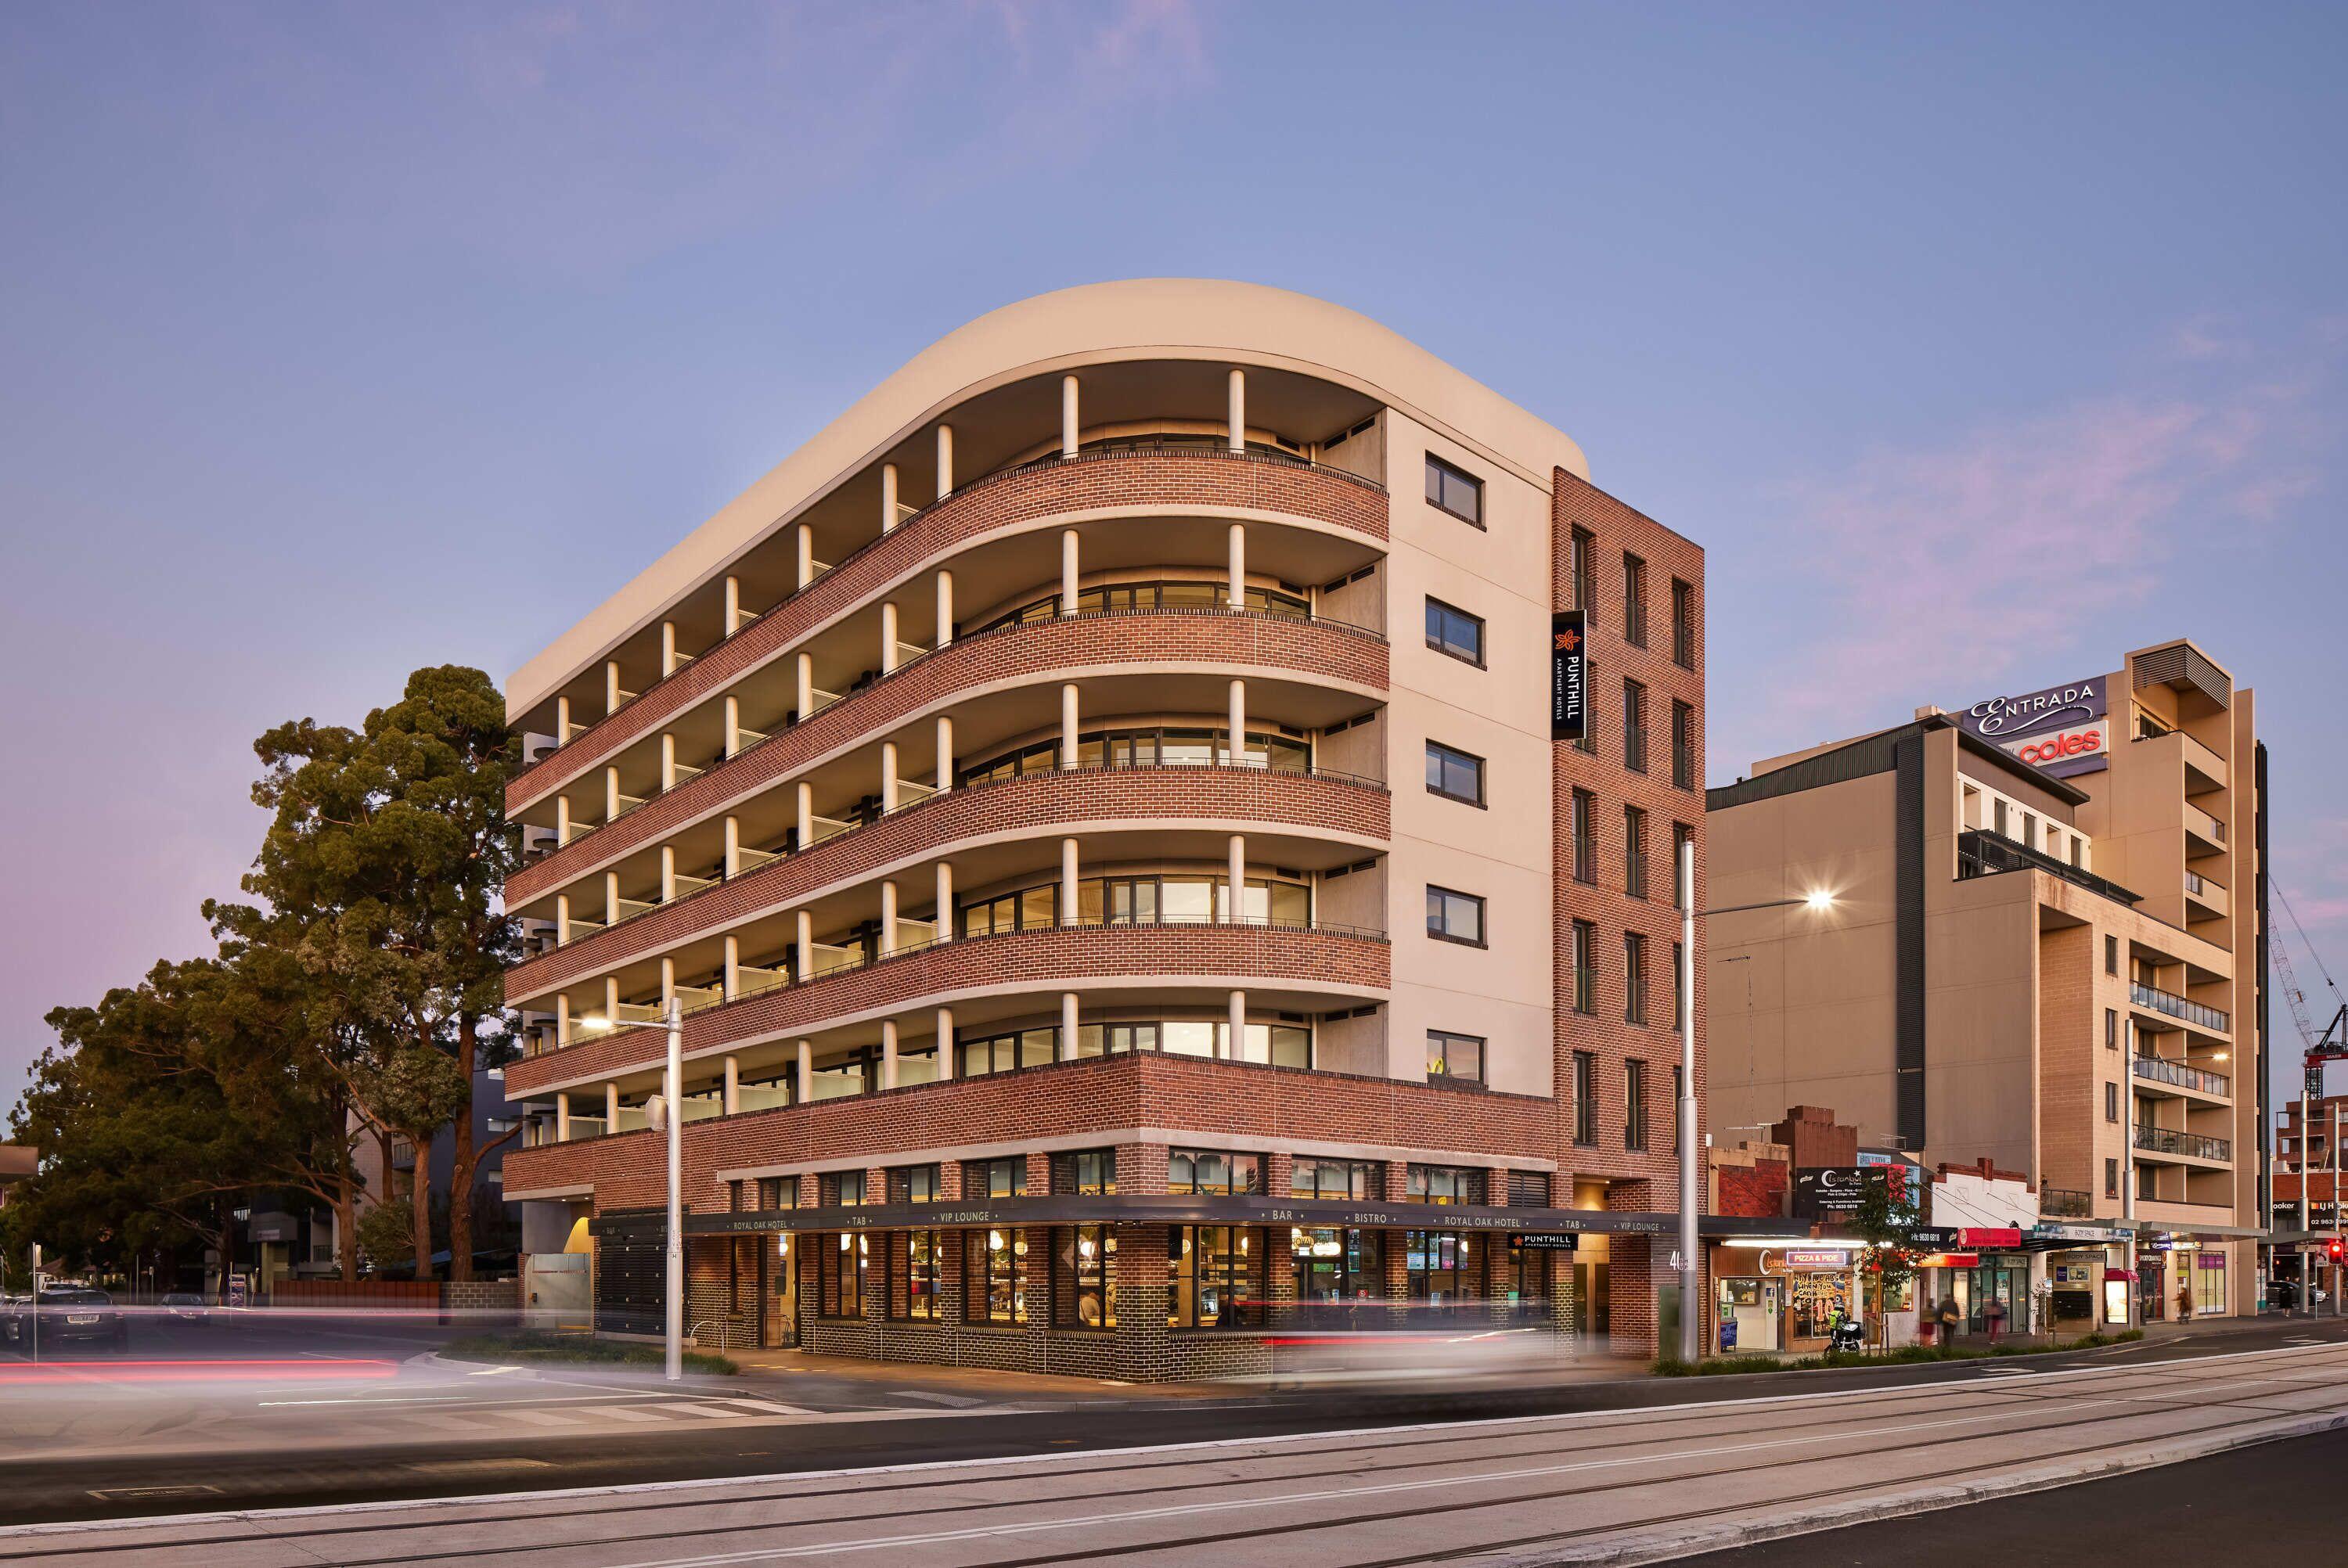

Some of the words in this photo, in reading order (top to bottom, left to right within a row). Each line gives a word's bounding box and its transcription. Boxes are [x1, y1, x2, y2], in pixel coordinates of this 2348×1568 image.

[1568, 656, 1579, 719] PUNTHILL
[2020, 730, 2101, 764] coles
[941, 1213, 953, 1222] VIP
[955, 1211, 989, 1222] LOUNGE
[1273, 1210, 1293, 1221] BAR
[1355, 1214, 1388, 1224] BISTRO
[733, 1221, 753, 1230] ROYAL
[754, 1221, 766, 1229] OAK
[768, 1220, 787, 1229] HOTEL
[852, 1217, 866, 1225] TAB
[1445, 1217, 1472, 1226] ROYAL
[1475, 1217, 1492, 1227] OAK
[1495, 1218, 1521, 1228] HOTEL
[1565, 1221, 1580, 1229] TAB
[1620, 1222, 1631, 1231] VIP
[1633, 1222, 1659, 1232] LOUNGE
[1919, 1233, 1929, 1242] 9630
[1930, 1233, 1940, 1242] 6818
